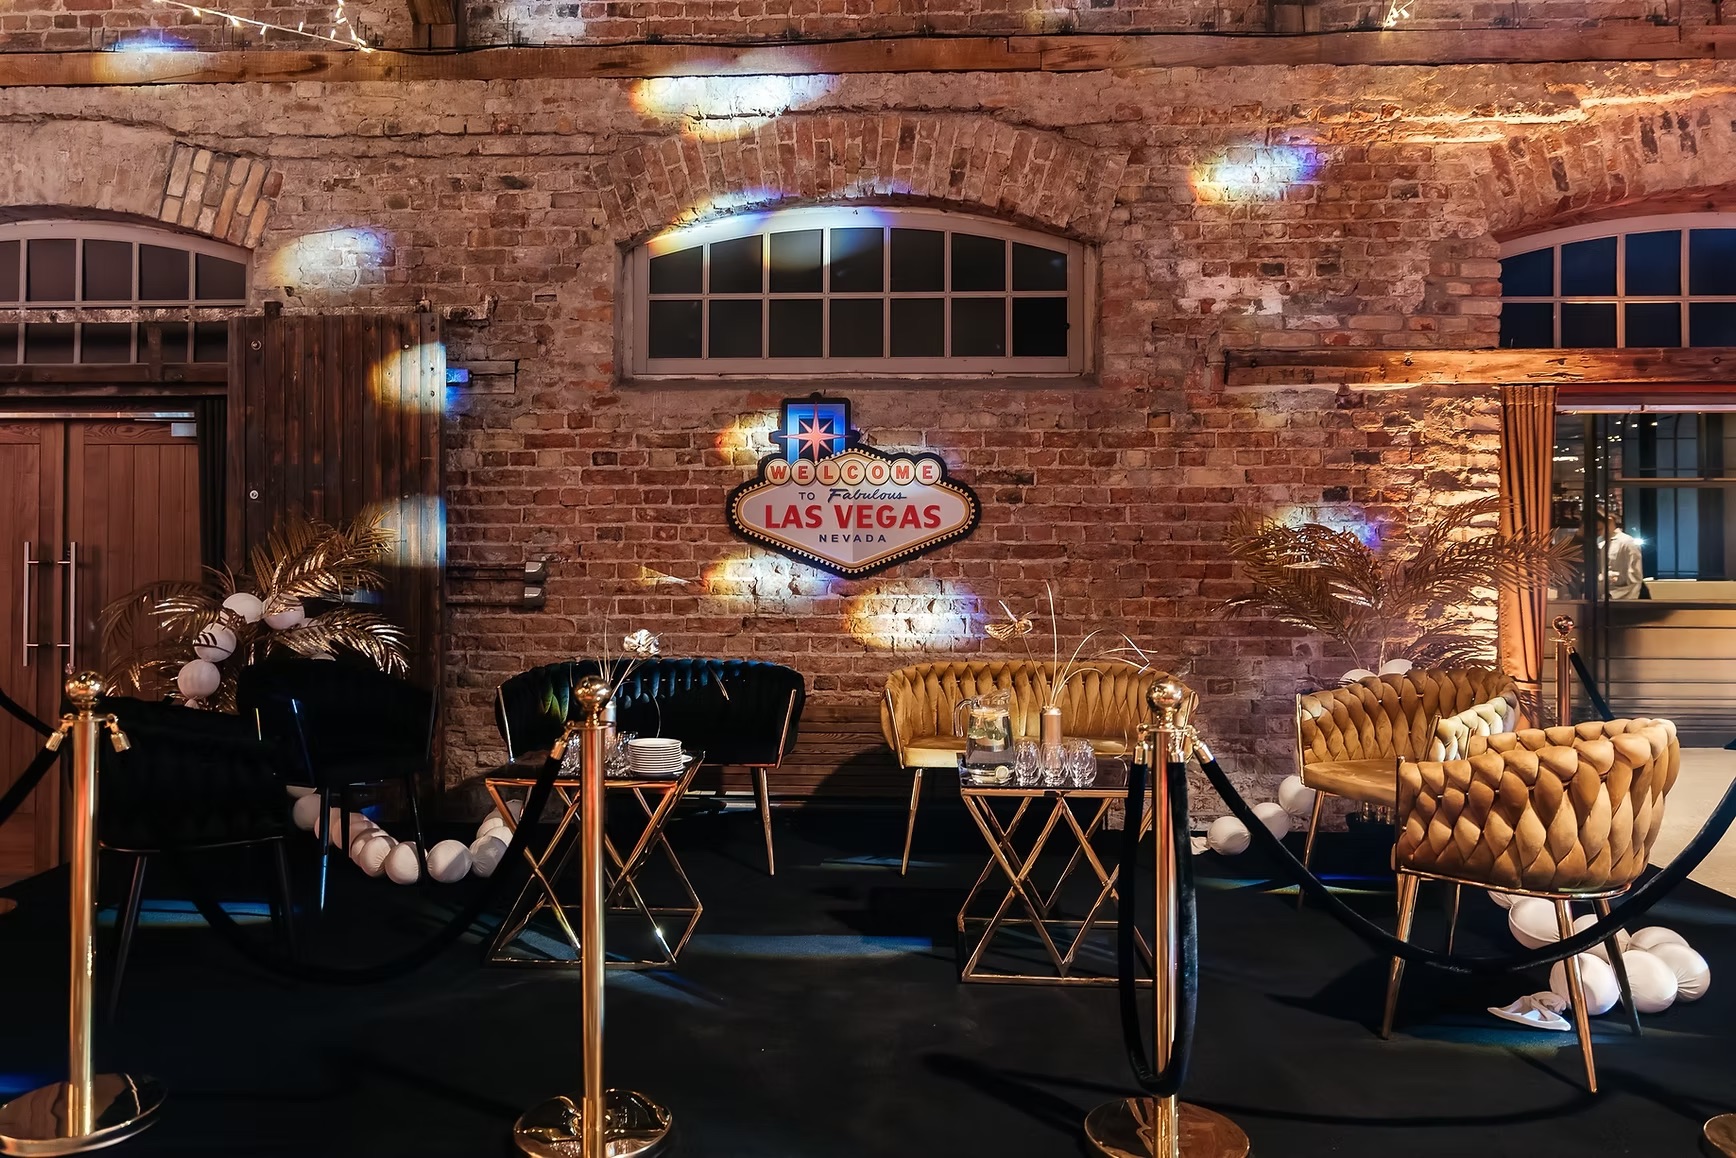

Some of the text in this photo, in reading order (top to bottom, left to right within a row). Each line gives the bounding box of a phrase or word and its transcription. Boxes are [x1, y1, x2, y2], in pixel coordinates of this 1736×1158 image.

[770, 465, 933, 480] WELCOME
[798, 488, 907, 503] TO Fabulous
[765, 504, 941, 529] LAS VEGAS
[819, 534, 887, 543] NEVADA
